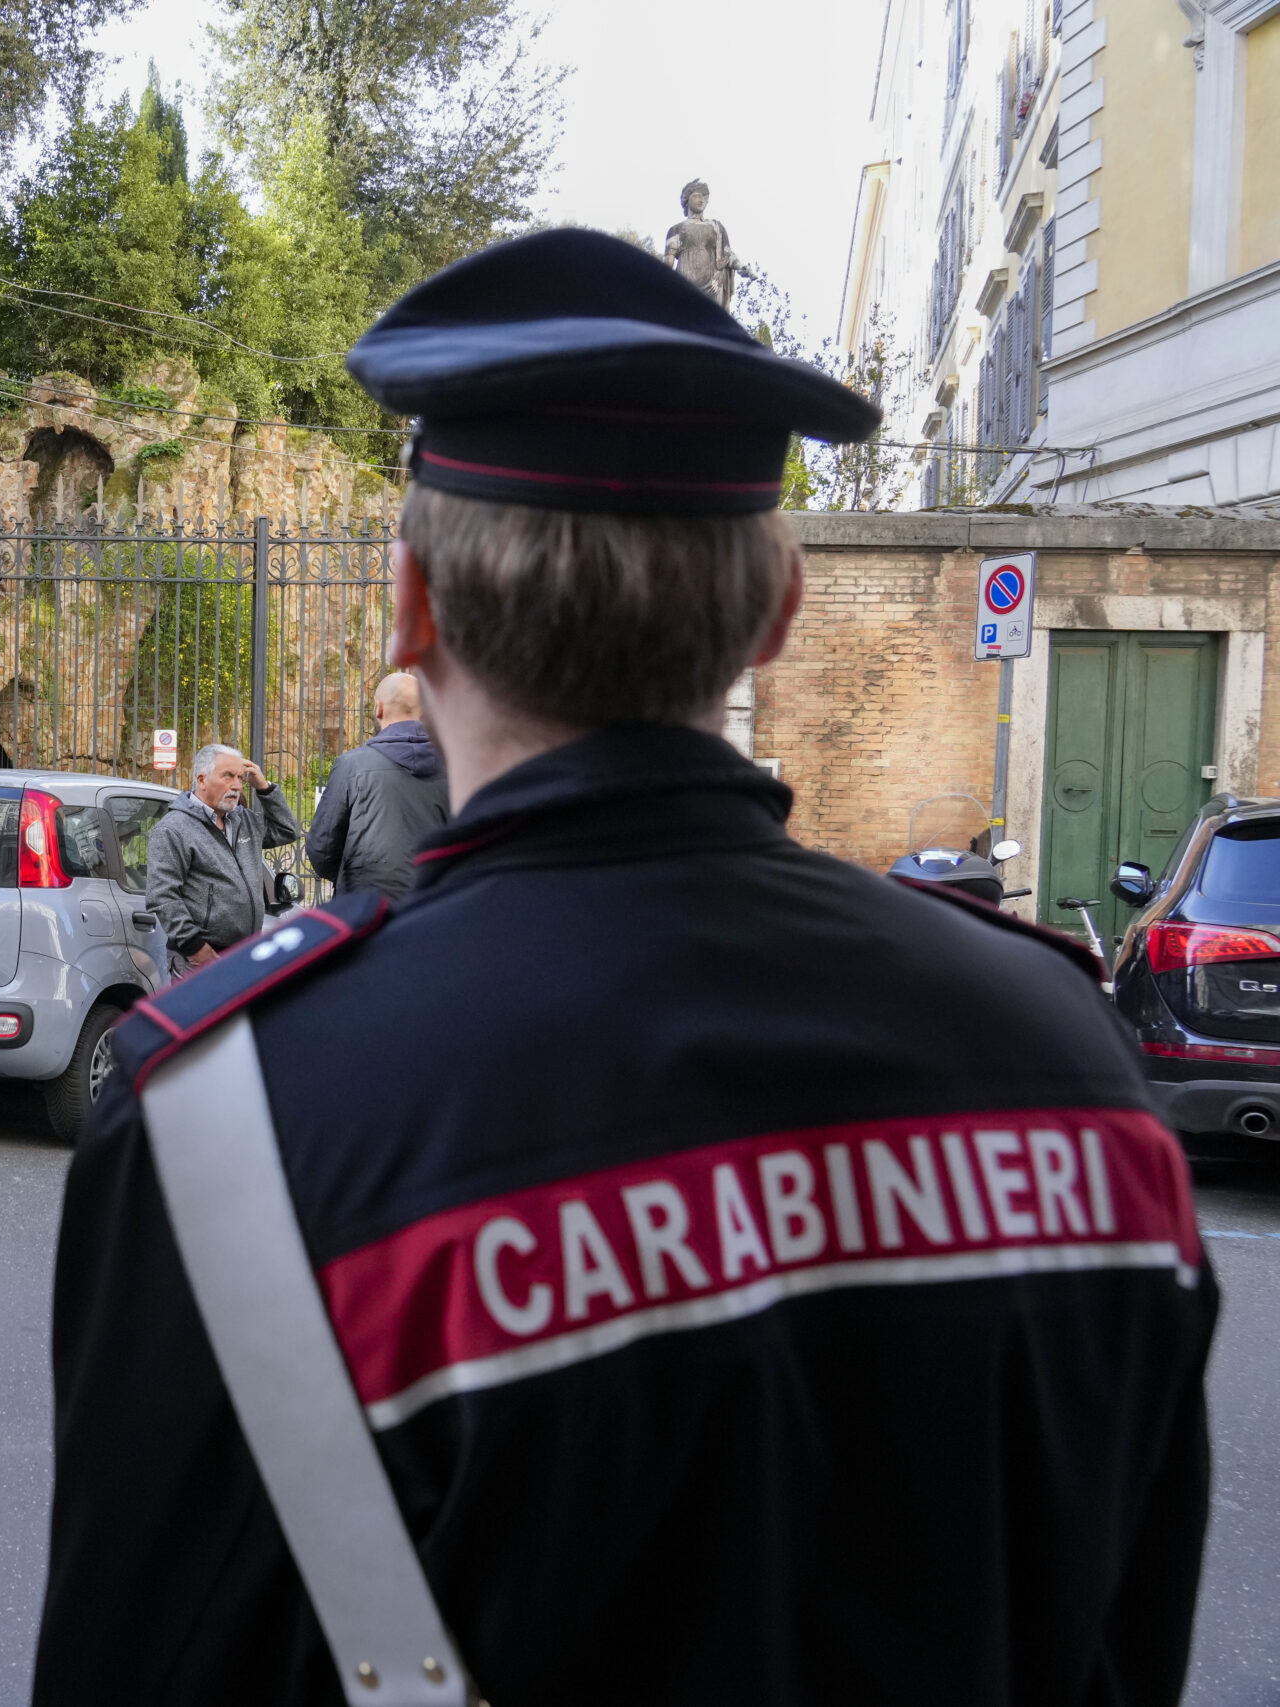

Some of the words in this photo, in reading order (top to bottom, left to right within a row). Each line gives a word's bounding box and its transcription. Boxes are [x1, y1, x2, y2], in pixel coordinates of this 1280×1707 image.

[983, 626, 994, 641] P
[1239, 980, 1277, 993] Q5
[474, 1129, 1117, 1336] CARABINIERI
